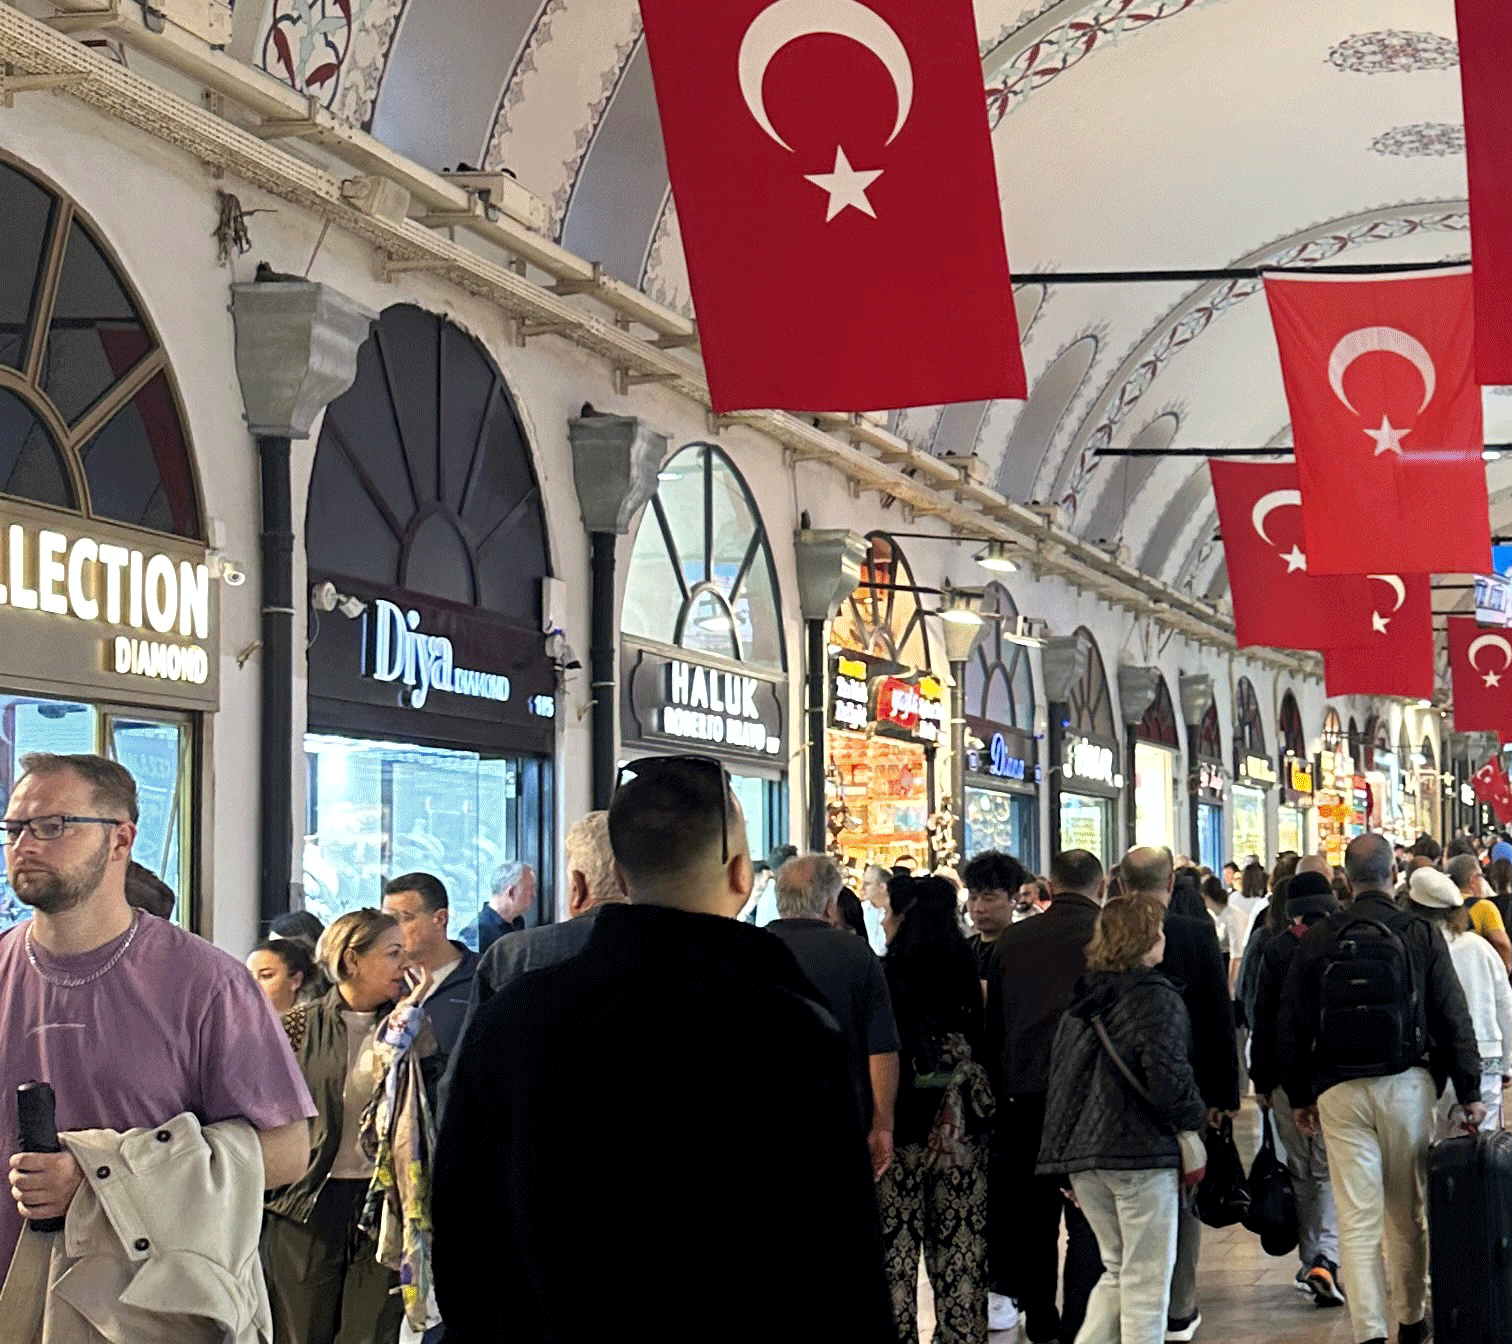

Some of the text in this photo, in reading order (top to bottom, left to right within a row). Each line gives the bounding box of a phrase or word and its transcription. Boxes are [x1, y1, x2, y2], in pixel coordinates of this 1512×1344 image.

[0, 524, 209, 639] LECTION
[114, 636, 208, 684] DIAMOND
[374, 599, 511, 709] Diya DIAMOND
[671, 660, 760, 719] HALUK
